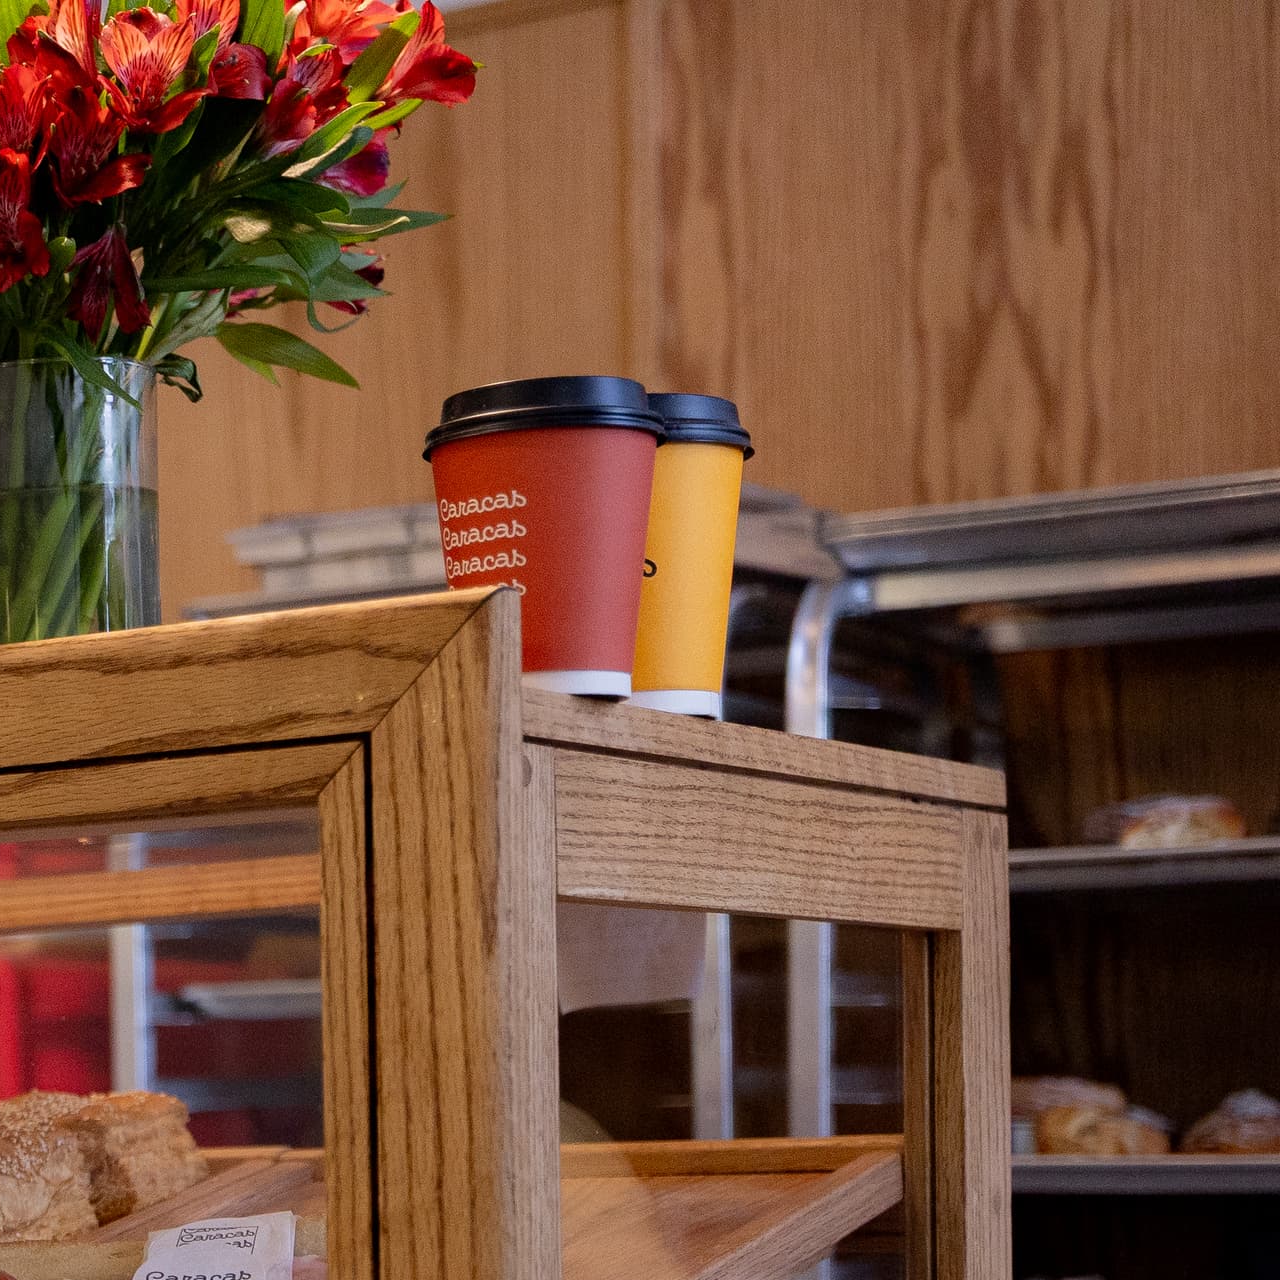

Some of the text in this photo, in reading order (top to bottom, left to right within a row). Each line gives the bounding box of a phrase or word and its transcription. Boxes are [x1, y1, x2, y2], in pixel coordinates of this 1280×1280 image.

[440, 490, 527, 521] Caracas
[443, 519, 527, 550] Caracas
[446, 549, 527, 579] Caracas
[181, 1229, 255, 1243] Caracas
